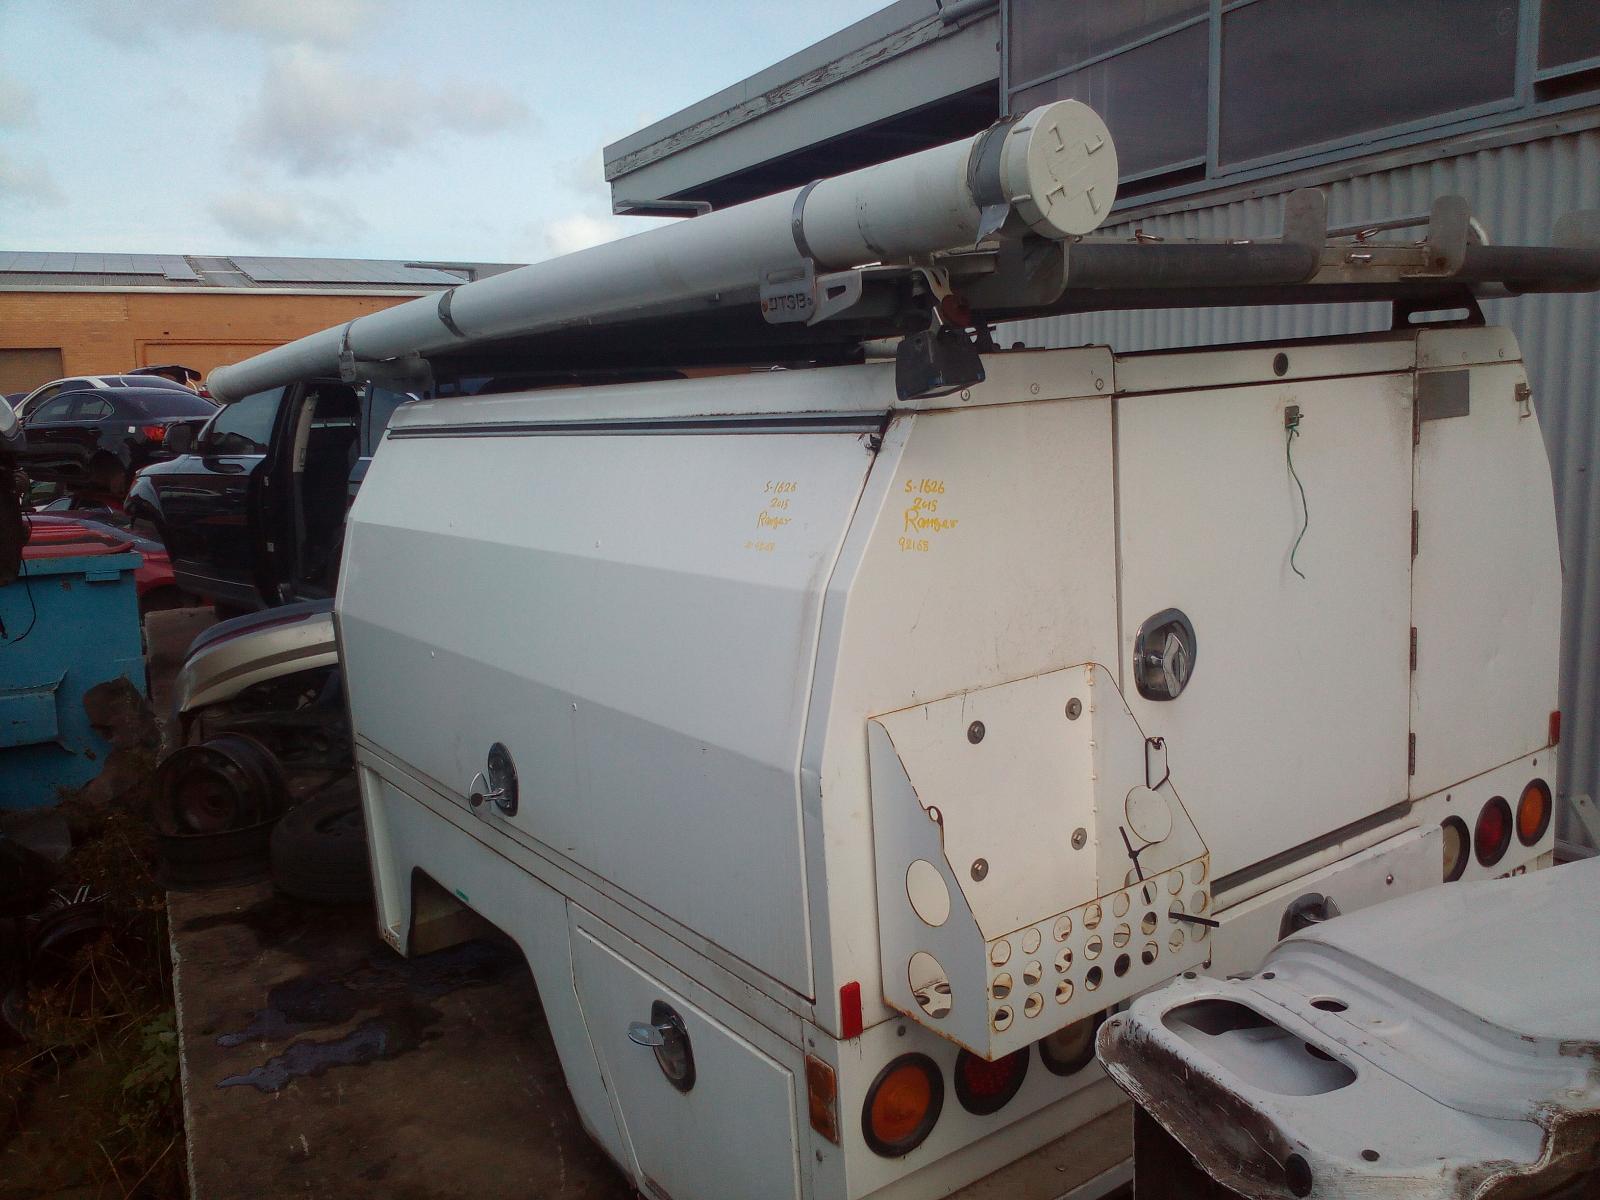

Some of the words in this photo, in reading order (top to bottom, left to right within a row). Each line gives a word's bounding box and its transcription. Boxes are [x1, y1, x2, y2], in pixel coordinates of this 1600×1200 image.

[764, 480, 797, 494] S-1626
[904, 479, 945, 494] S-1626
[770, 497, 790, 510] 2015
[911, 497, 938, 512] 2015
[904, 510, 959, 532] Ranger
